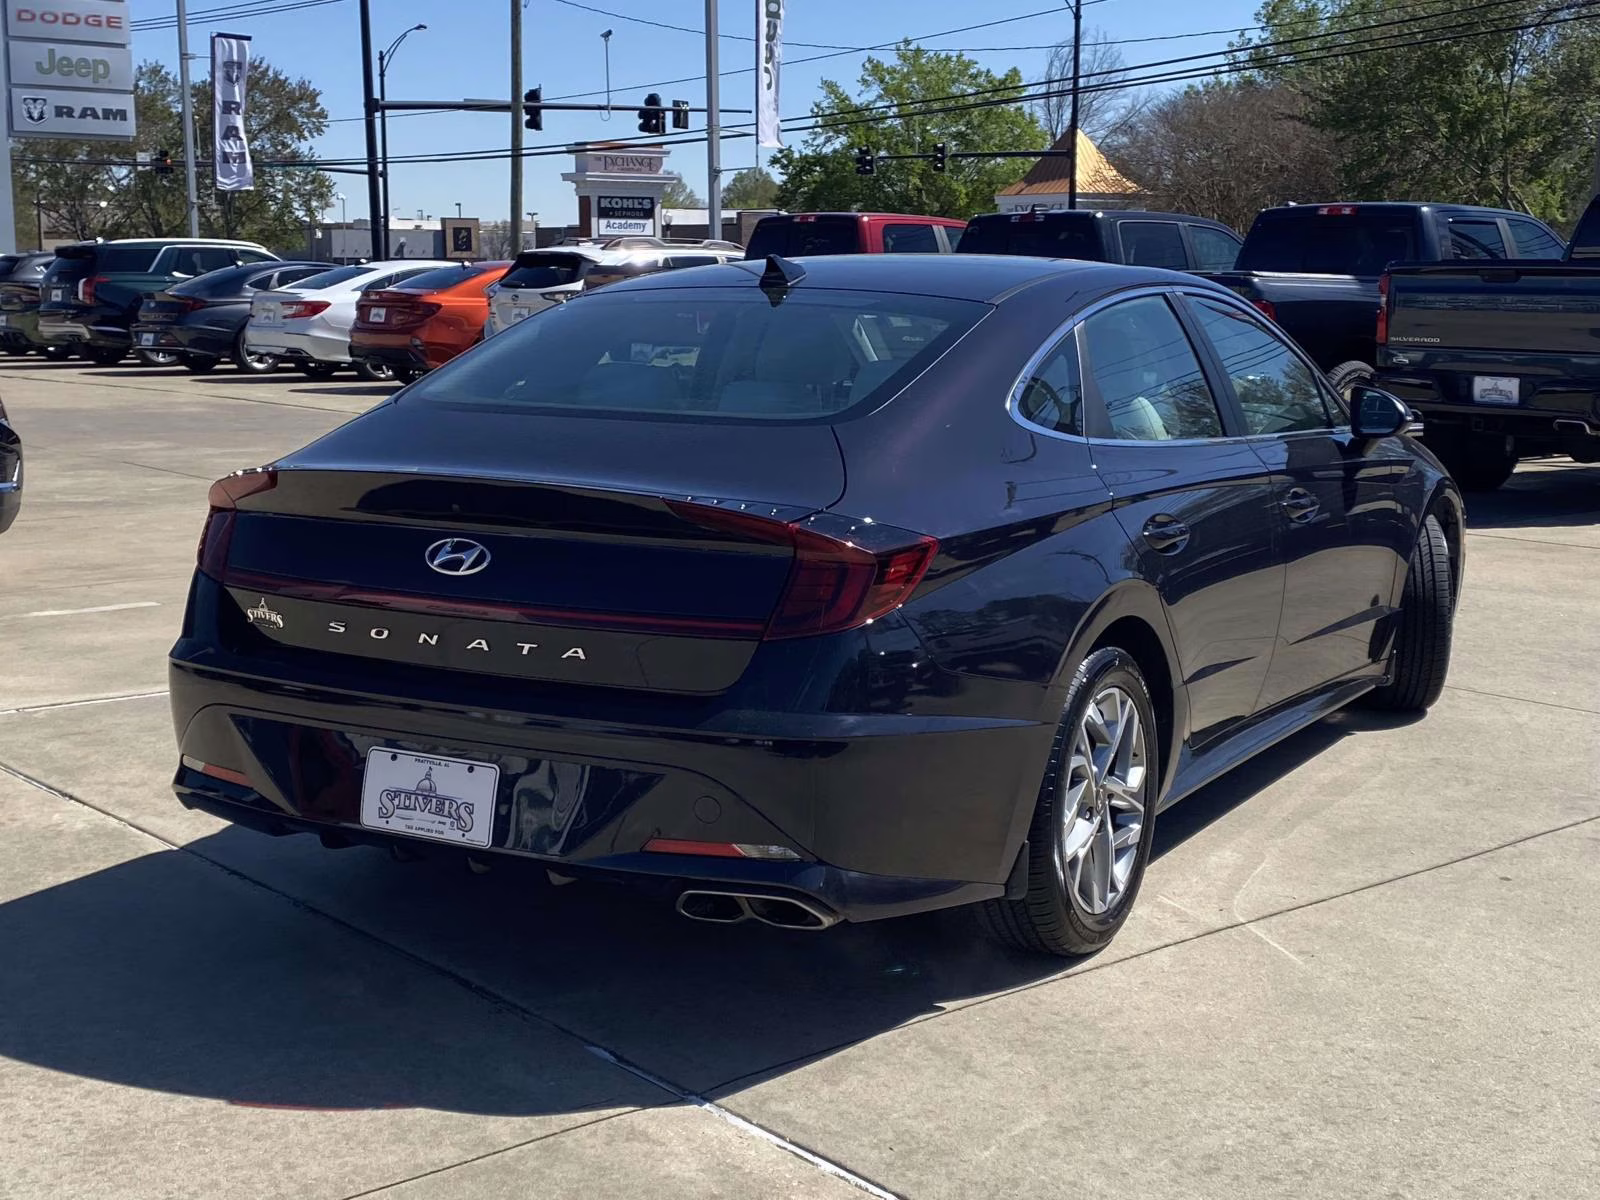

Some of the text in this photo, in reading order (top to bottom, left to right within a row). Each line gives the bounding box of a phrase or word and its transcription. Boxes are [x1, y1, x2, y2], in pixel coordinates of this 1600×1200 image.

[16, 9, 122, 29] DODGE
[35, 48, 110, 83] Jeep
[54, 105, 127, 121] RAM
[600, 198, 652, 209] KOHL'S
[605, 220, 648, 233] Academy
[247, 608, 284, 628] STIVERS
[328, 620, 587, 660] SONATA
[378, 788, 475, 833] STIVERS
